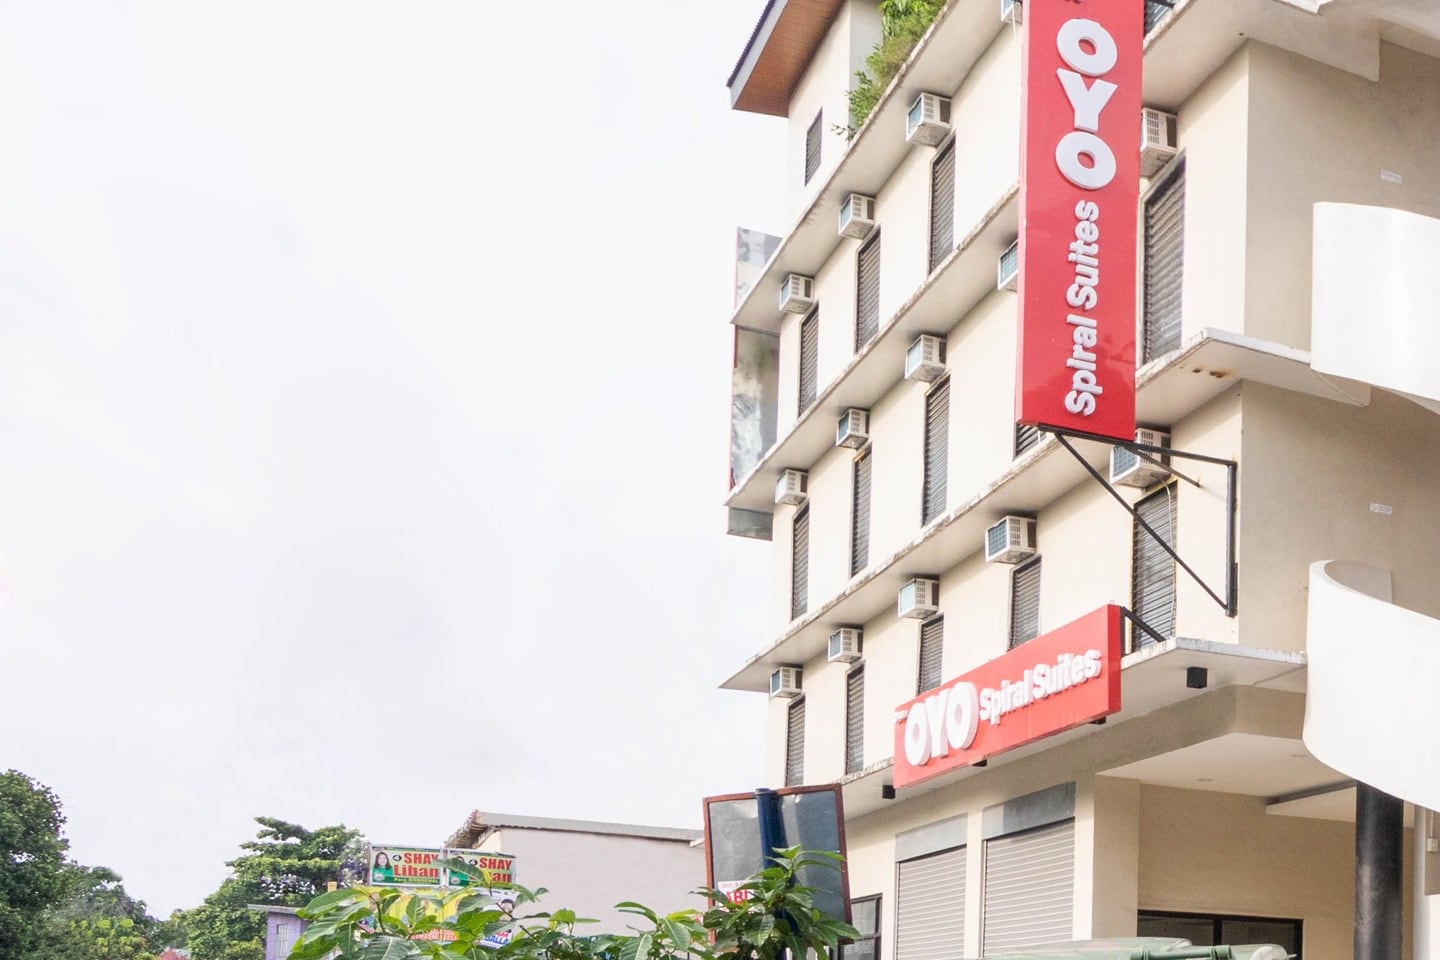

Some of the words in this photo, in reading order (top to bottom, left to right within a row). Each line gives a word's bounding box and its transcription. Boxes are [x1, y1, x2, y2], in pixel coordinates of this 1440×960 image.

[1056, 18, 1117, 190] OYO
[1066, 199, 1099, 310] Suites
[1065, 313, 1103, 416] Spiral
[904, 681, 979, 765] OYO
[980, 669, 1035, 726] Spiral
[1033, 649, 1102, 700] Suites
[394, 864, 439, 878] Liban
[480, 857, 512, 871] SHAY
